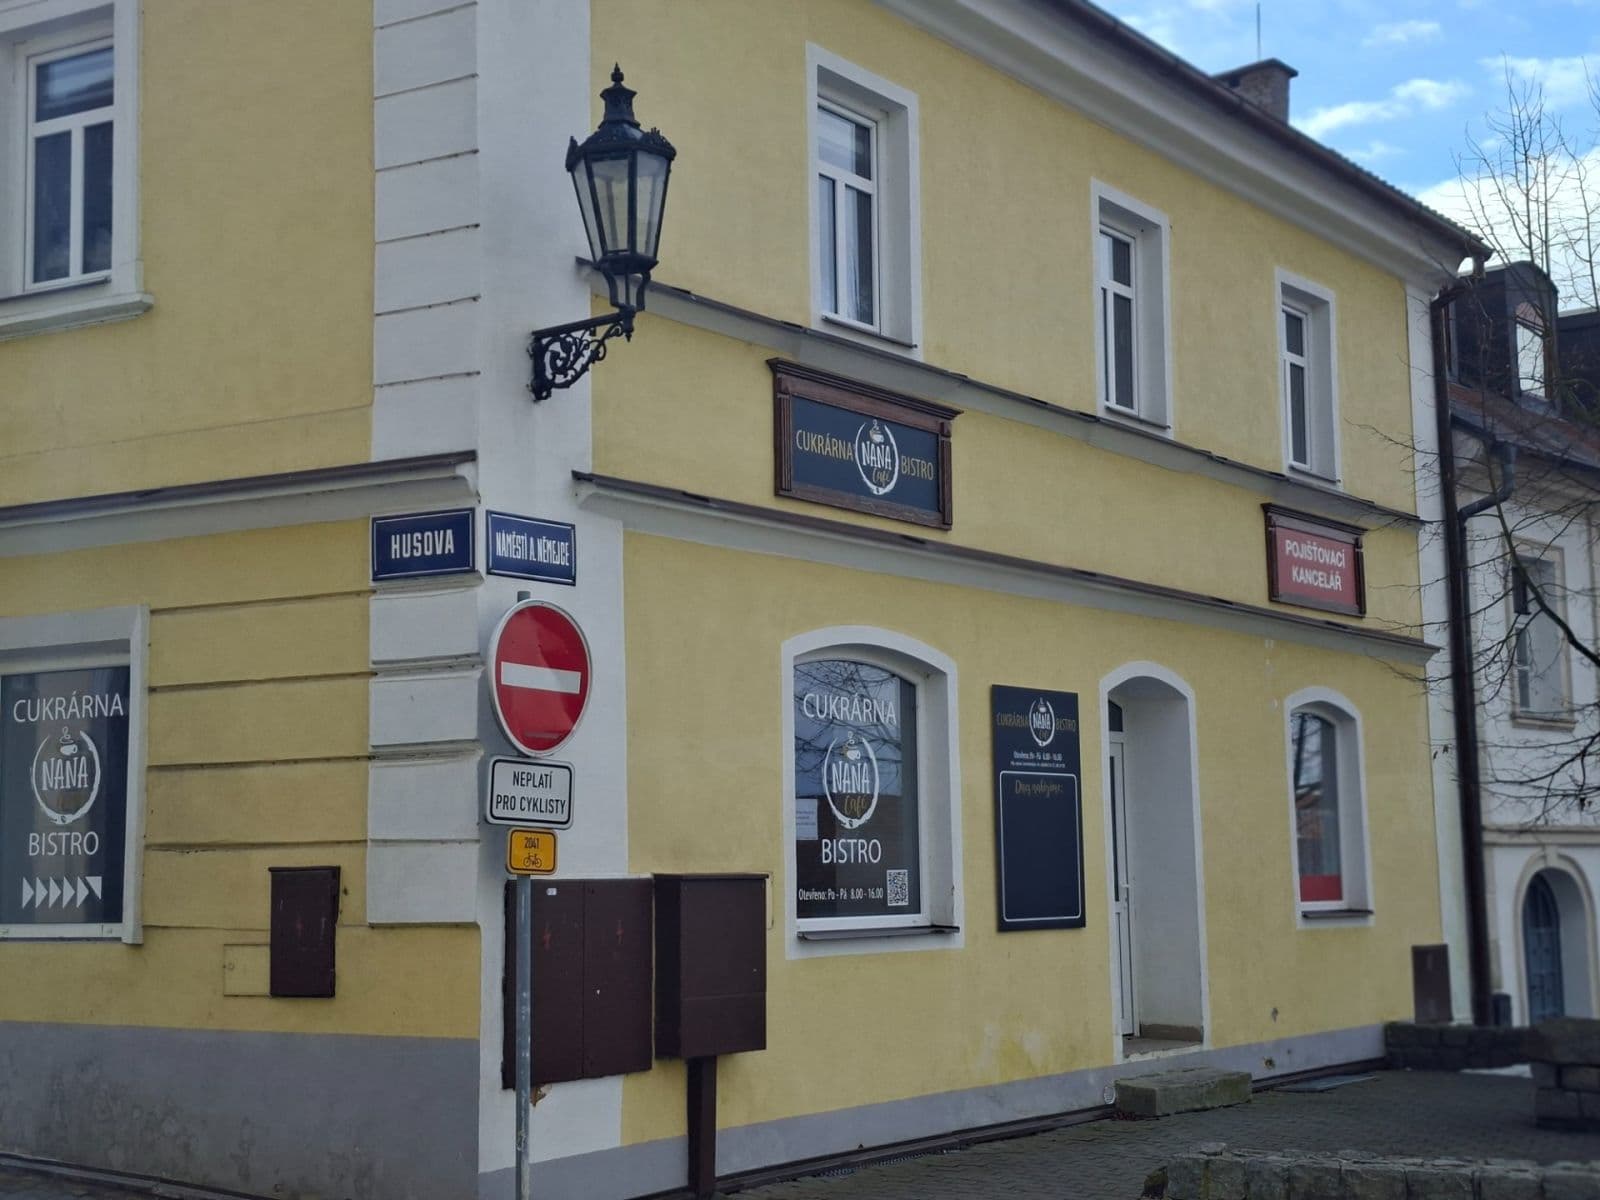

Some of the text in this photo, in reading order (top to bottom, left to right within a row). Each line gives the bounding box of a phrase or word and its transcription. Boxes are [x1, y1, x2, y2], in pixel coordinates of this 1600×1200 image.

[796, 429, 934, 480] CUKRÁRNA NANA BISTRO
[391, 529, 455, 559] HUSOVA
[495, 529, 570, 567] NÁMĚSTÍ A. NĚMEJCE
[1285, 539, 1345, 568] POJIŠŤOVACÍ
[1292, 565, 1342, 591] KANCELÁŘ
[13, 690, 124, 723] CUKRÁRNA
[803, 692, 897, 725] CUKRÁRNA
[1033, 711, 1051, 730] NANA
[42, 755, 89, 791] NANA
[512, 770, 553, 789] NEPLATÍ
[832, 761, 870, 794] NANA
[495, 794, 566, 815] PRO CYKLISTY
[844, 794, 867, 818] Café
[28, 831, 99, 856] BISTRO
[524, 837, 539, 849] 2041
[822, 838, 882, 864] BISTRO
[827, 888, 835, 900] Po
[868, 887, 884, 899] 16.00
